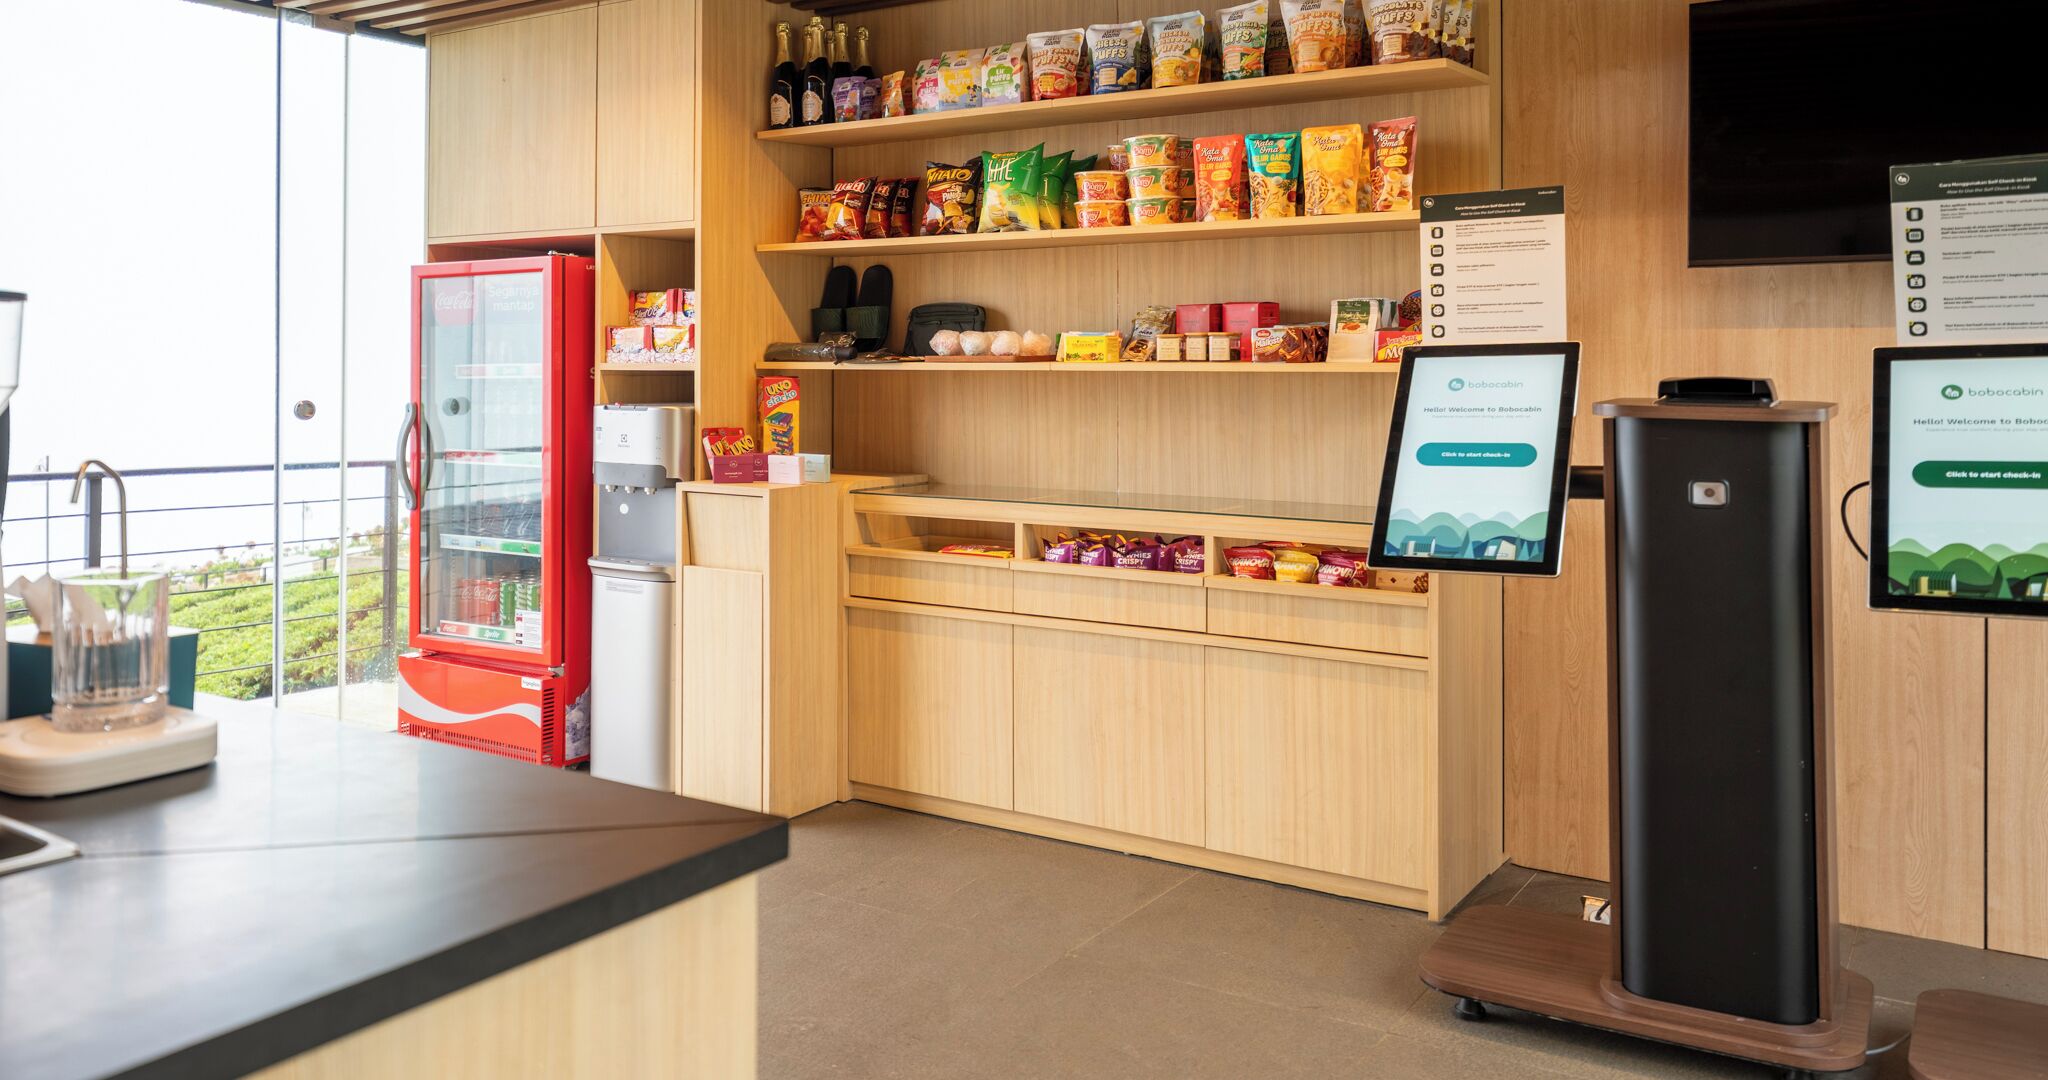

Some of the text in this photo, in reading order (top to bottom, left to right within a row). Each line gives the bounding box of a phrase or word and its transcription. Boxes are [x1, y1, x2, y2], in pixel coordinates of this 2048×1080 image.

[765, 380, 792, 396] UNO
[1468, 380, 1524, 389] bobocabin
[766, 389, 797, 408] stacko
[1968, 387, 2044, 397] bobocabin
[728, 434, 755, 456] UNO
[2002, 471, 2041, 479] check-in
